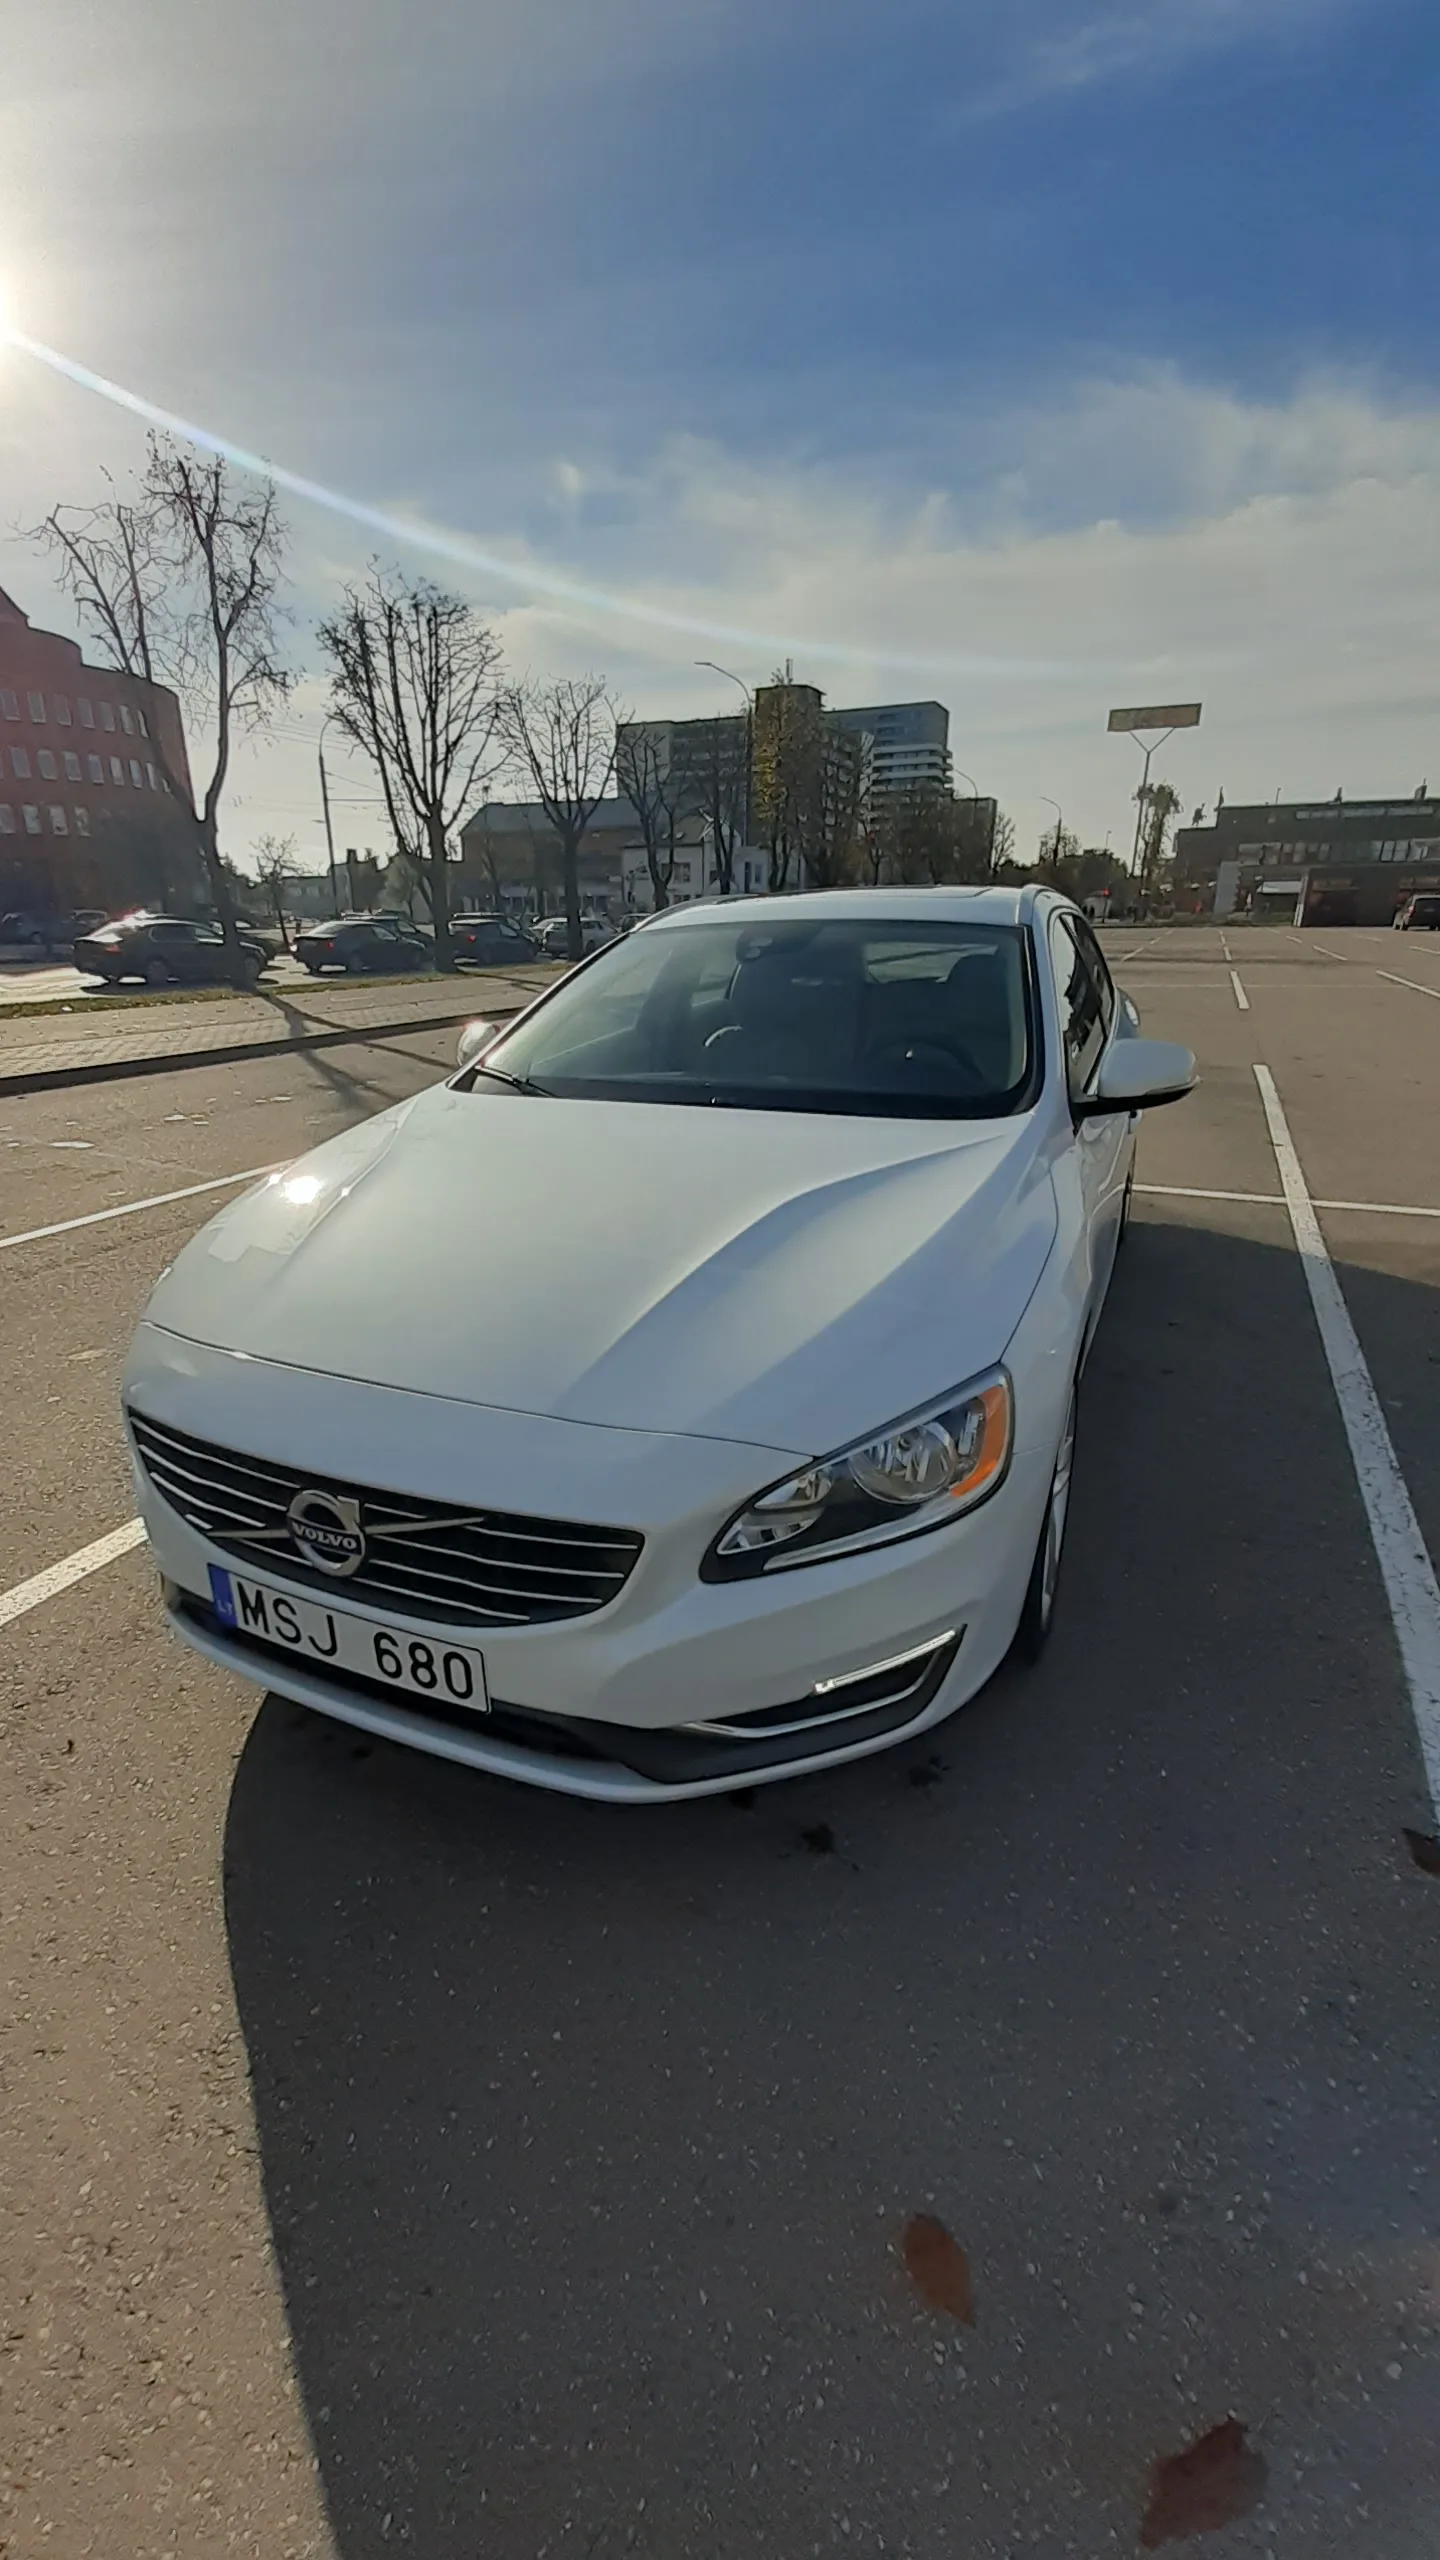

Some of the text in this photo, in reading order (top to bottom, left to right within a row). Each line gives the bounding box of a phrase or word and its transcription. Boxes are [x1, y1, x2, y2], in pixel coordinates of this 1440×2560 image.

[293, 1522, 357, 1551] VOLVO
[237, 1580, 474, 1700] MSJ 680
